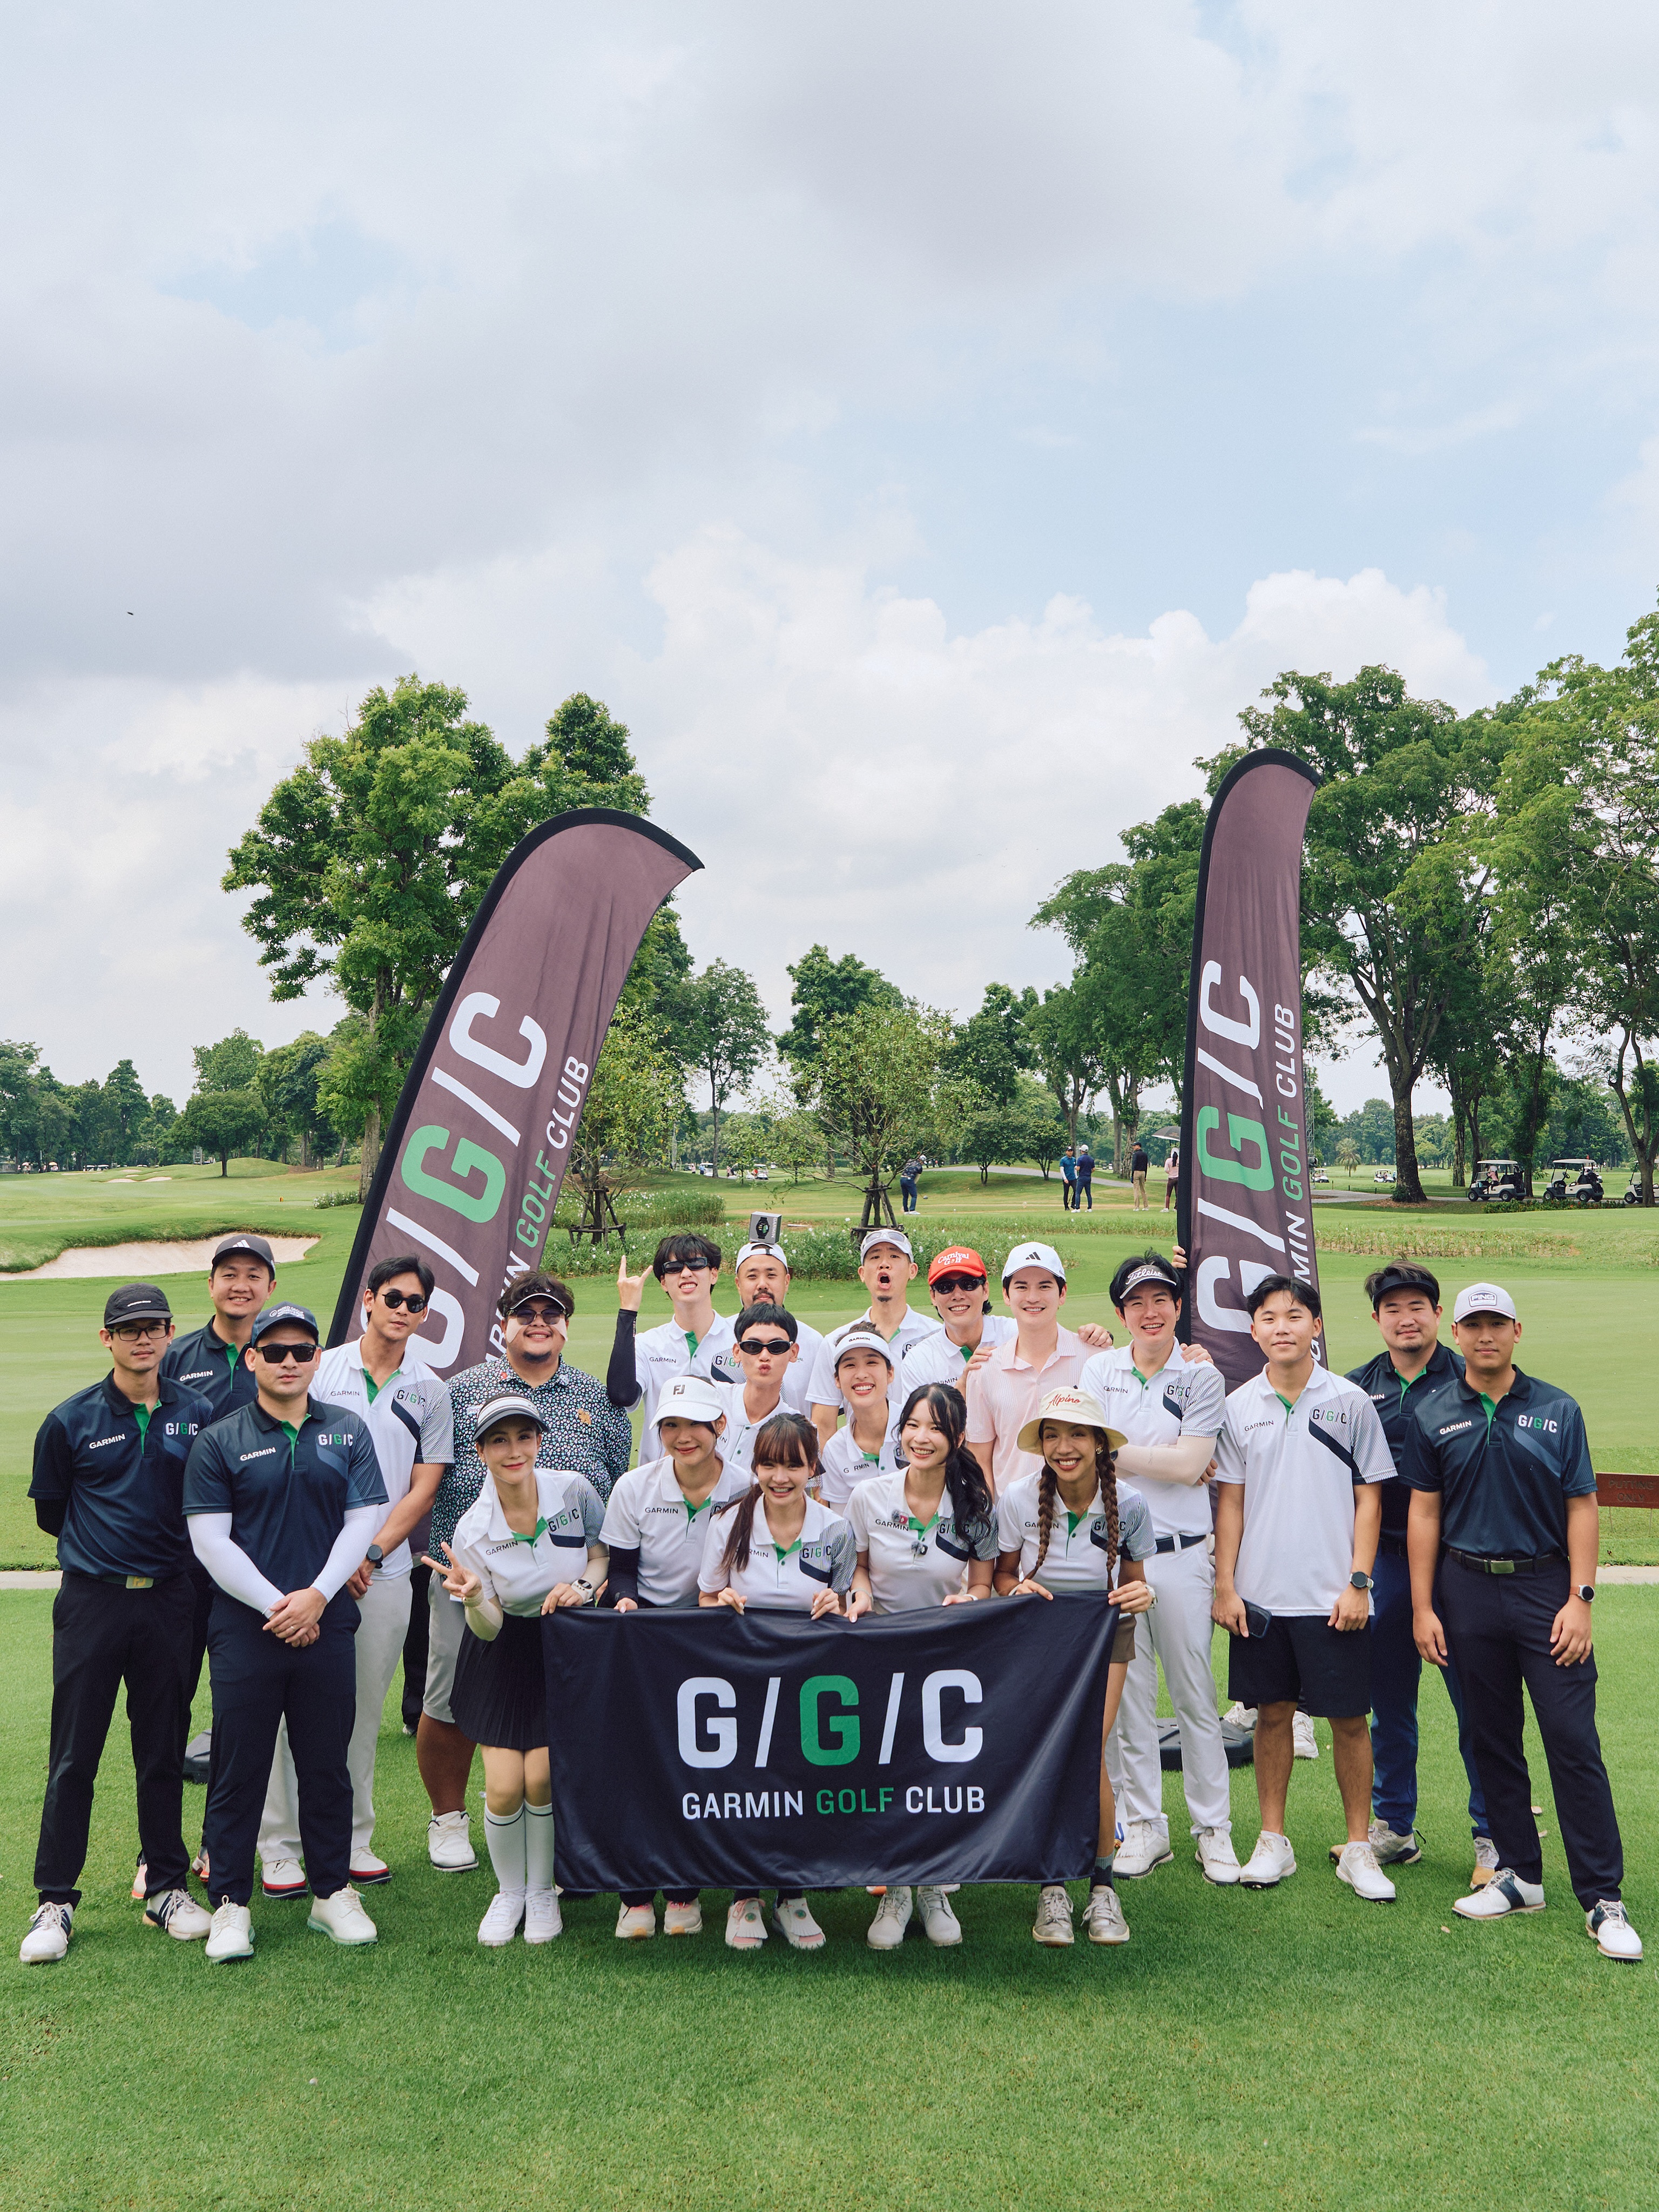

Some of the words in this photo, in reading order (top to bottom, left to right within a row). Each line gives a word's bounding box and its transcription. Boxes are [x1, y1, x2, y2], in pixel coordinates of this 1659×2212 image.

[1274, 1003, 1297, 1098] CLUB
[516, 1149, 556, 1248] GOLF
[547, 1056, 589, 1149] CLUB
[1278, 1105, 1303, 1201] GOLF
[938, 1251, 969, 1264] Carnival
[1125, 1268, 1163, 1285] Titleist
[180, 1370, 213, 1381] GARMIN
[673, 1384, 685, 1395] FJ
[1046, 1394, 1081, 1410] Alpino
[165, 1422, 198, 1436] G/G/C
[1244, 1420, 1274, 1432] GARMIN
[1439, 1420, 1472, 1435] GARMIN
[1518, 1414, 1557, 1433] G/G/C
[89, 1433, 126, 1449] GARMIN
[240, 1447, 276, 1461] GARMIN
[844, 1462, 869, 1474] GRMIN
[1609, 1480, 1654, 1490] PUTTING
[1617, 1493, 1644, 1502] ONLY
[548, 1508, 579, 1532] G/G/C
[875, 1519, 909, 1531] GARMIN
[486, 1541, 518, 1556] GARMIN
[677, 1669, 983, 1768] G/G/C
[682, 1790, 804, 1819] GARMIN
[816, 1787, 894, 1814] GOLF
[906, 1786, 984, 1813] CLUB
